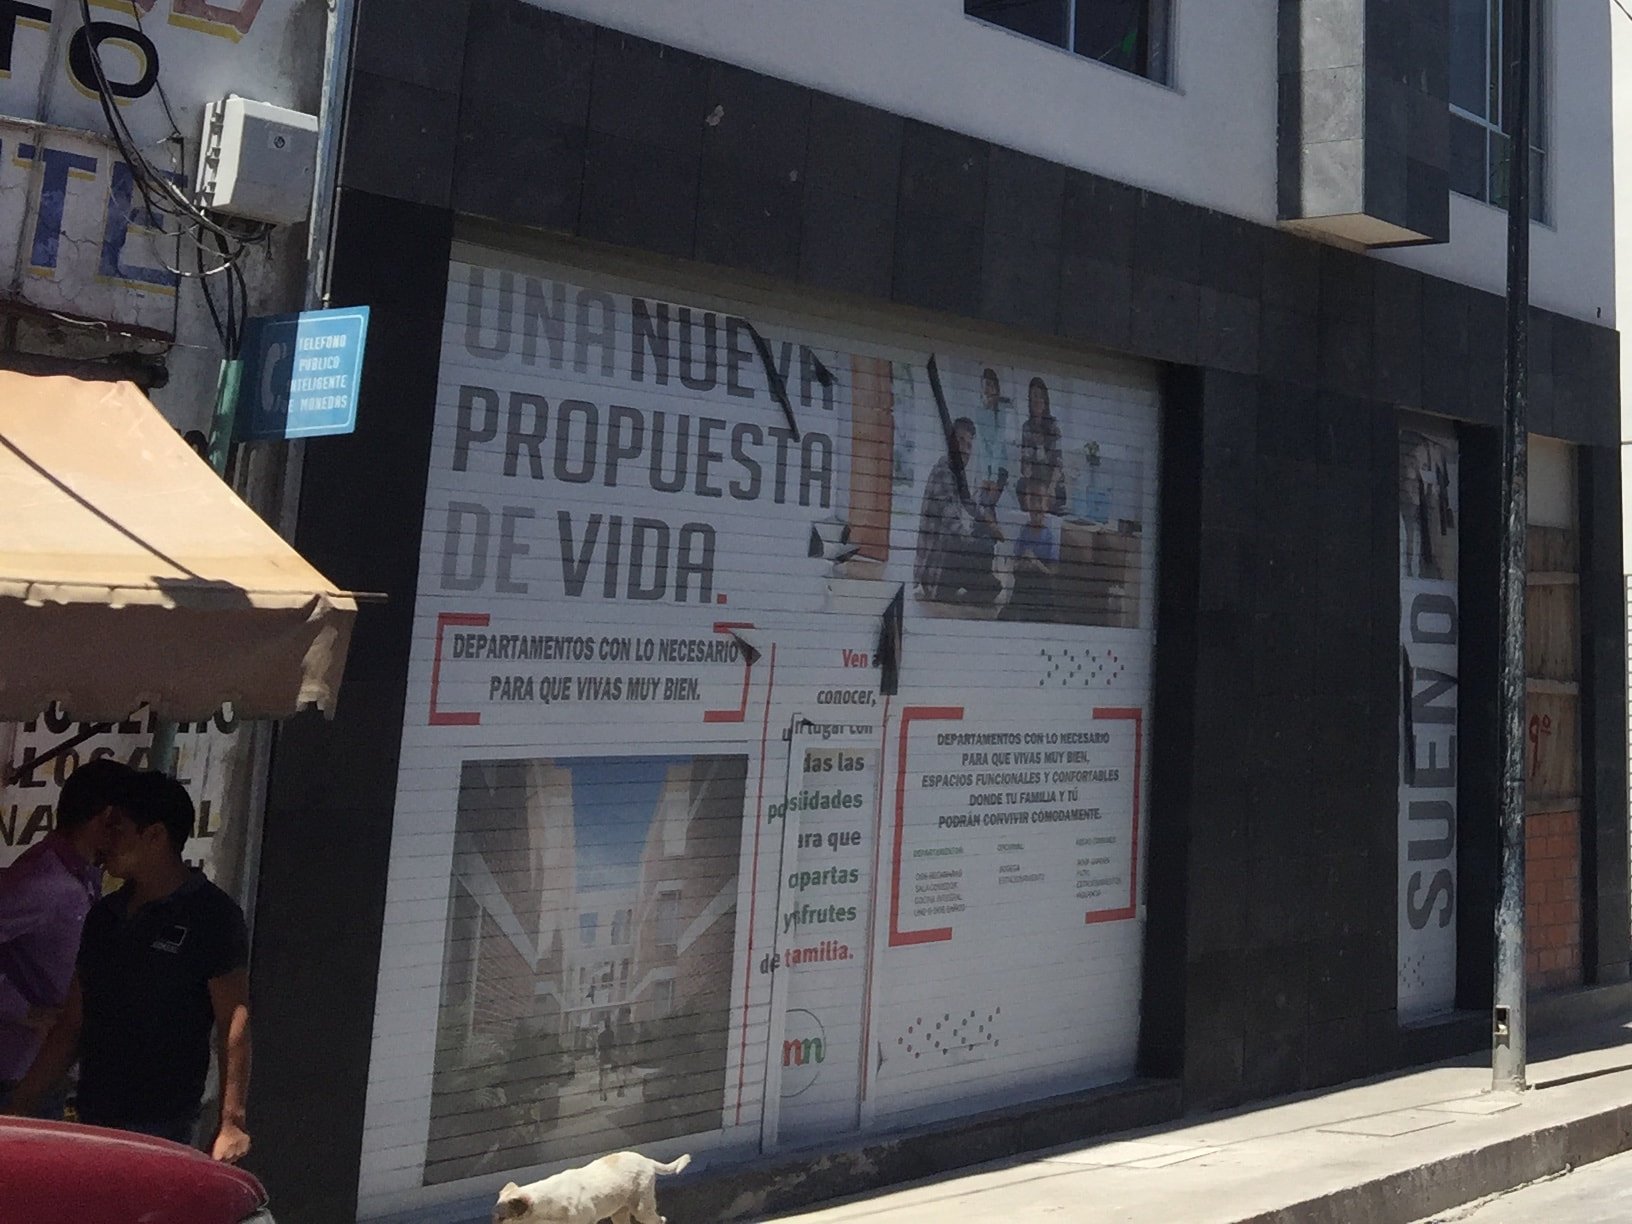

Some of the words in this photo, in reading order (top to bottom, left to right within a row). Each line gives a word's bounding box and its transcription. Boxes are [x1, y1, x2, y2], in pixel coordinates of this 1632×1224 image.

[464, 266, 615, 374] UNA
[452, 384, 833, 509] PROPUESTA
[440, 501, 535, 594] DE
[557, 510, 728, 605] VIDA.
[453, 634, 594, 660] DEPARTAMENTOS
[599, 637, 632, 661] CON
[636, 638, 654, 662] LO
[659, 638, 739, 663] NECESARIO
[842, 649, 868, 668] Ven
[489, 676, 533, 701] PARA
[539, 677, 572, 704] QUE
[577, 677, 621, 701] VIVAS
[626, 677, 660, 701] MUY
[817, 689, 876, 707] conocer,
[937, 732, 1021, 745] DEPARTAMENTOS
[1024, 732, 1044, 745] CON
[1046, 732, 1058, 744] LO
[1060, 732, 1109, 744] NECESARIO
[962, 752, 988, 766] PARA
[991, 752, 1010, 767] QUE
[1014, 751, 1041, 765] VIVAS
[1044, 751, 1065, 764] MUY
[922, 774, 973, 787] ESPACIOS
[975, 772, 1040, 786] FUNCIONALES
[1043, 772, 1050, 783] Y
[1052, 769, 1119, 783] CONFORTABLES
[969, 792, 1002, 806] DONDE
[1006, 792, 1017, 804] TU
[1019, 790, 1056, 804] FAMILIA
[1059, 790, 1066, 802] Y
[983, 812, 1029, 827] CONVIVIR
[828, 829, 861, 852] que
